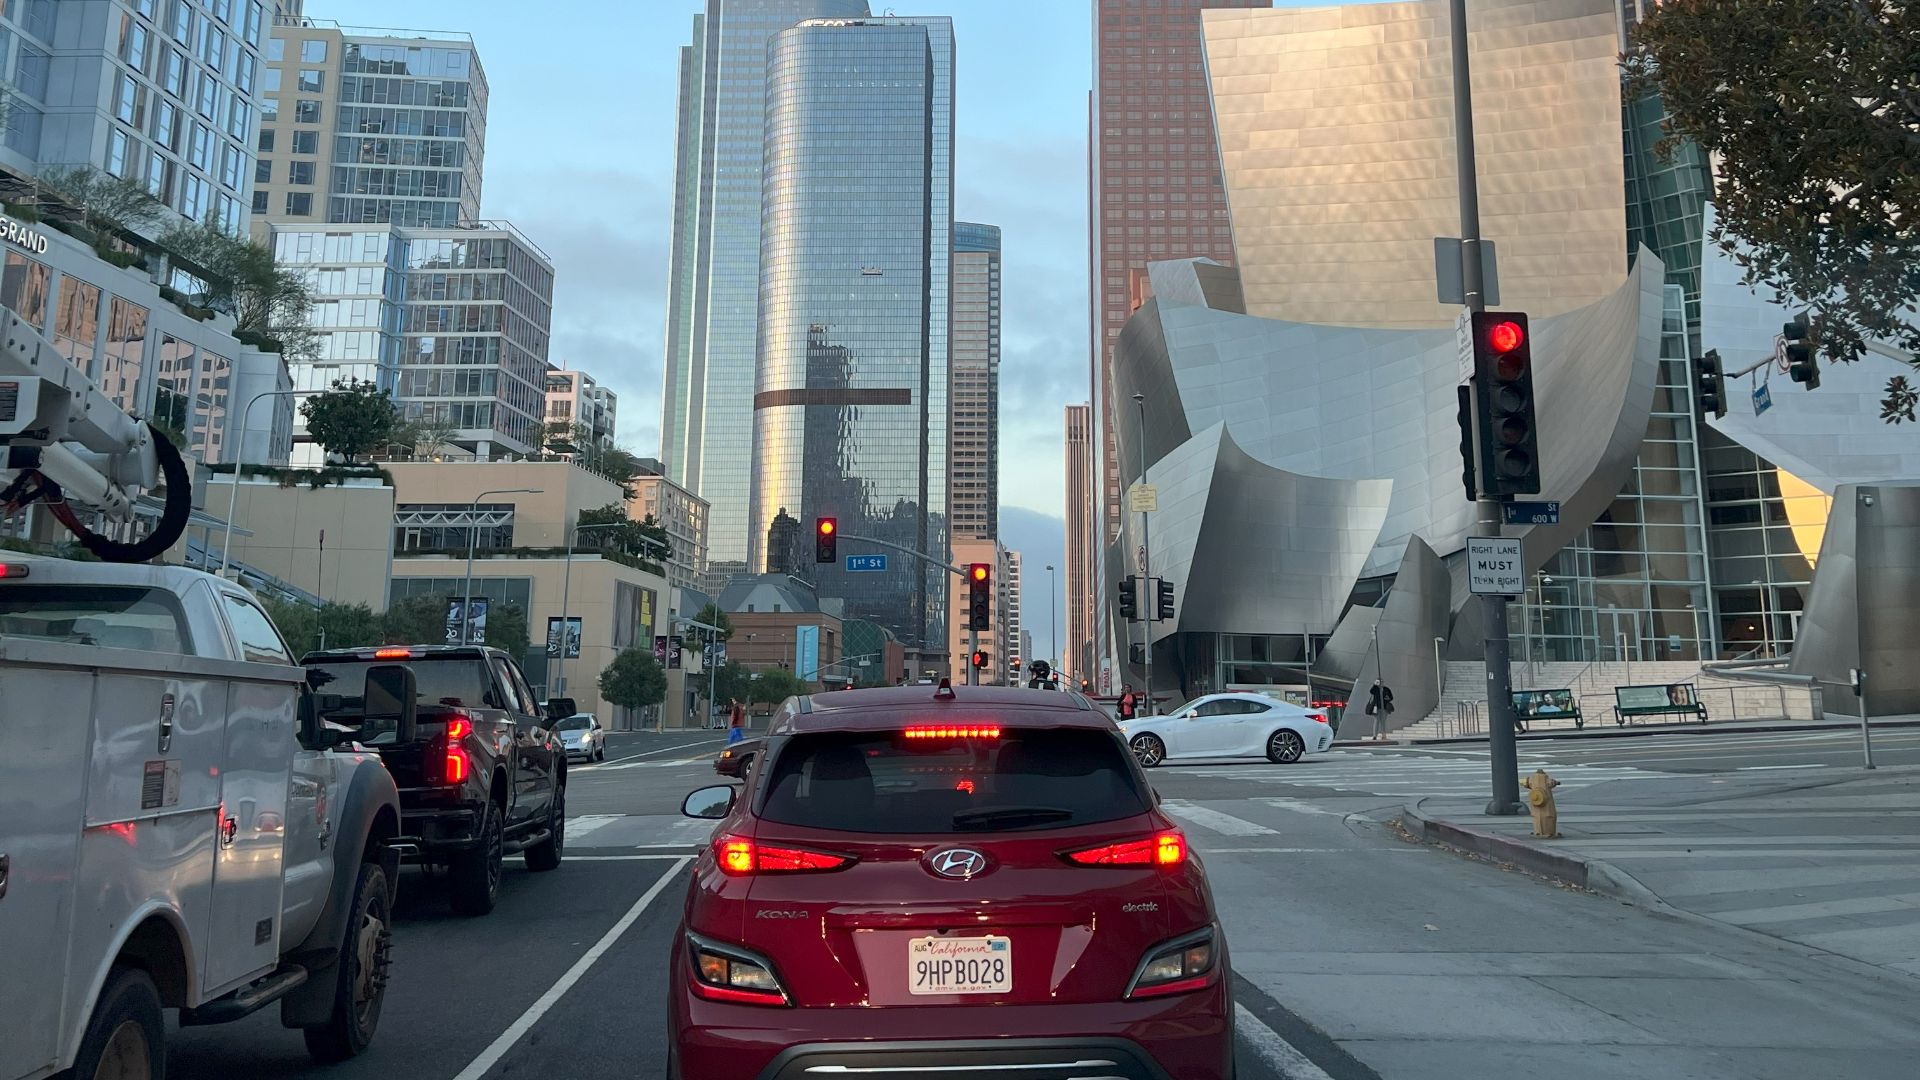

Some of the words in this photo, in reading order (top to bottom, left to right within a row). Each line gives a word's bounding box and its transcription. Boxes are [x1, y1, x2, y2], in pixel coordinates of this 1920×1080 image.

[0, 217, 48, 254] GRAND
[1547, 503, 1557, 512] St
[1532, 514, 1547, 523] 600
[1550, 515, 1557, 523] W
[1471, 546, 1493, 555] RIGHT
[1497, 546, 1519, 555] LANE
[852, 558, 866, 569] 1st
[870, 558, 882, 567] St
[1478, 561, 1513, 571] MUST
[1473, 576, 1494, 585] TURN
[1497, 576, 1520, 585] RIGHT
[1122, 901, 1159, 913] electric
[755, 910, 809, 919] KONA
[914, 944, 927, 953] AUG
[930, 941, 990, 958] California
[917, 958, 1005, 987] 9HPB028
